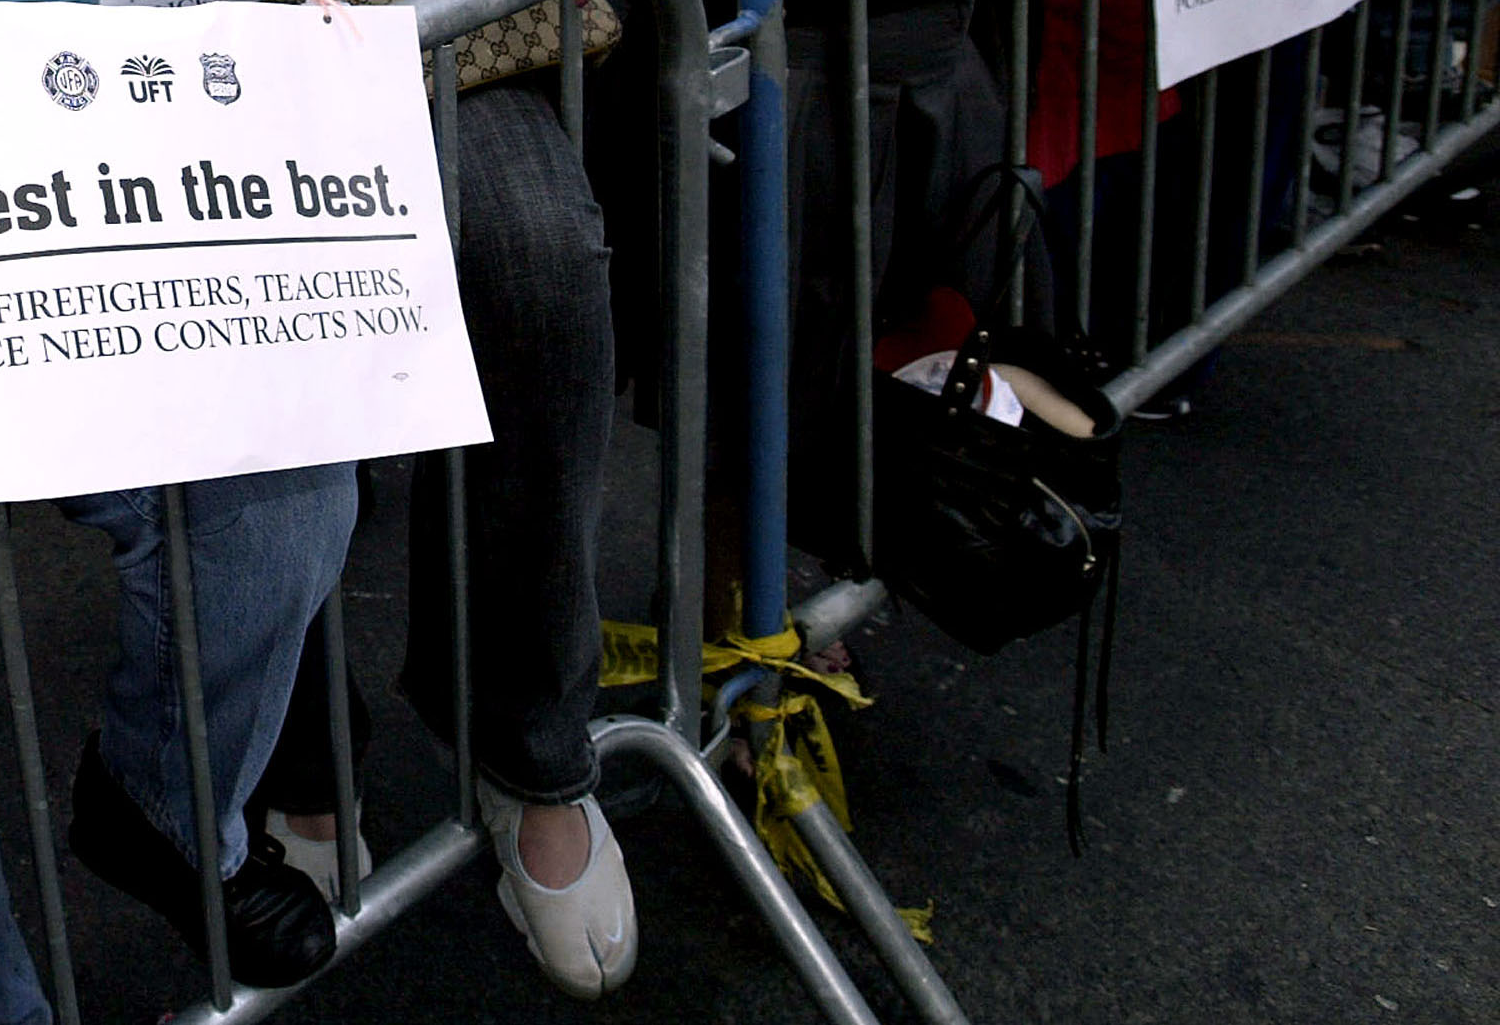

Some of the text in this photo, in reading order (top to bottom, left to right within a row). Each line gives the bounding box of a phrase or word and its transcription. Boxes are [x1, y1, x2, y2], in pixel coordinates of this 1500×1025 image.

[128, 80, 174, 104] UFT
[97, 162, 163, 225] in
[181, 160, 273, 221] the
[285, 160, 409, 219] best.
[254, 268, 411, 303] TEACHERS,
[40, 325, 143, 363] NEED
[154, 310, 348, 352] CONTRACTS
[354, 305, 429, 337] NOW.
